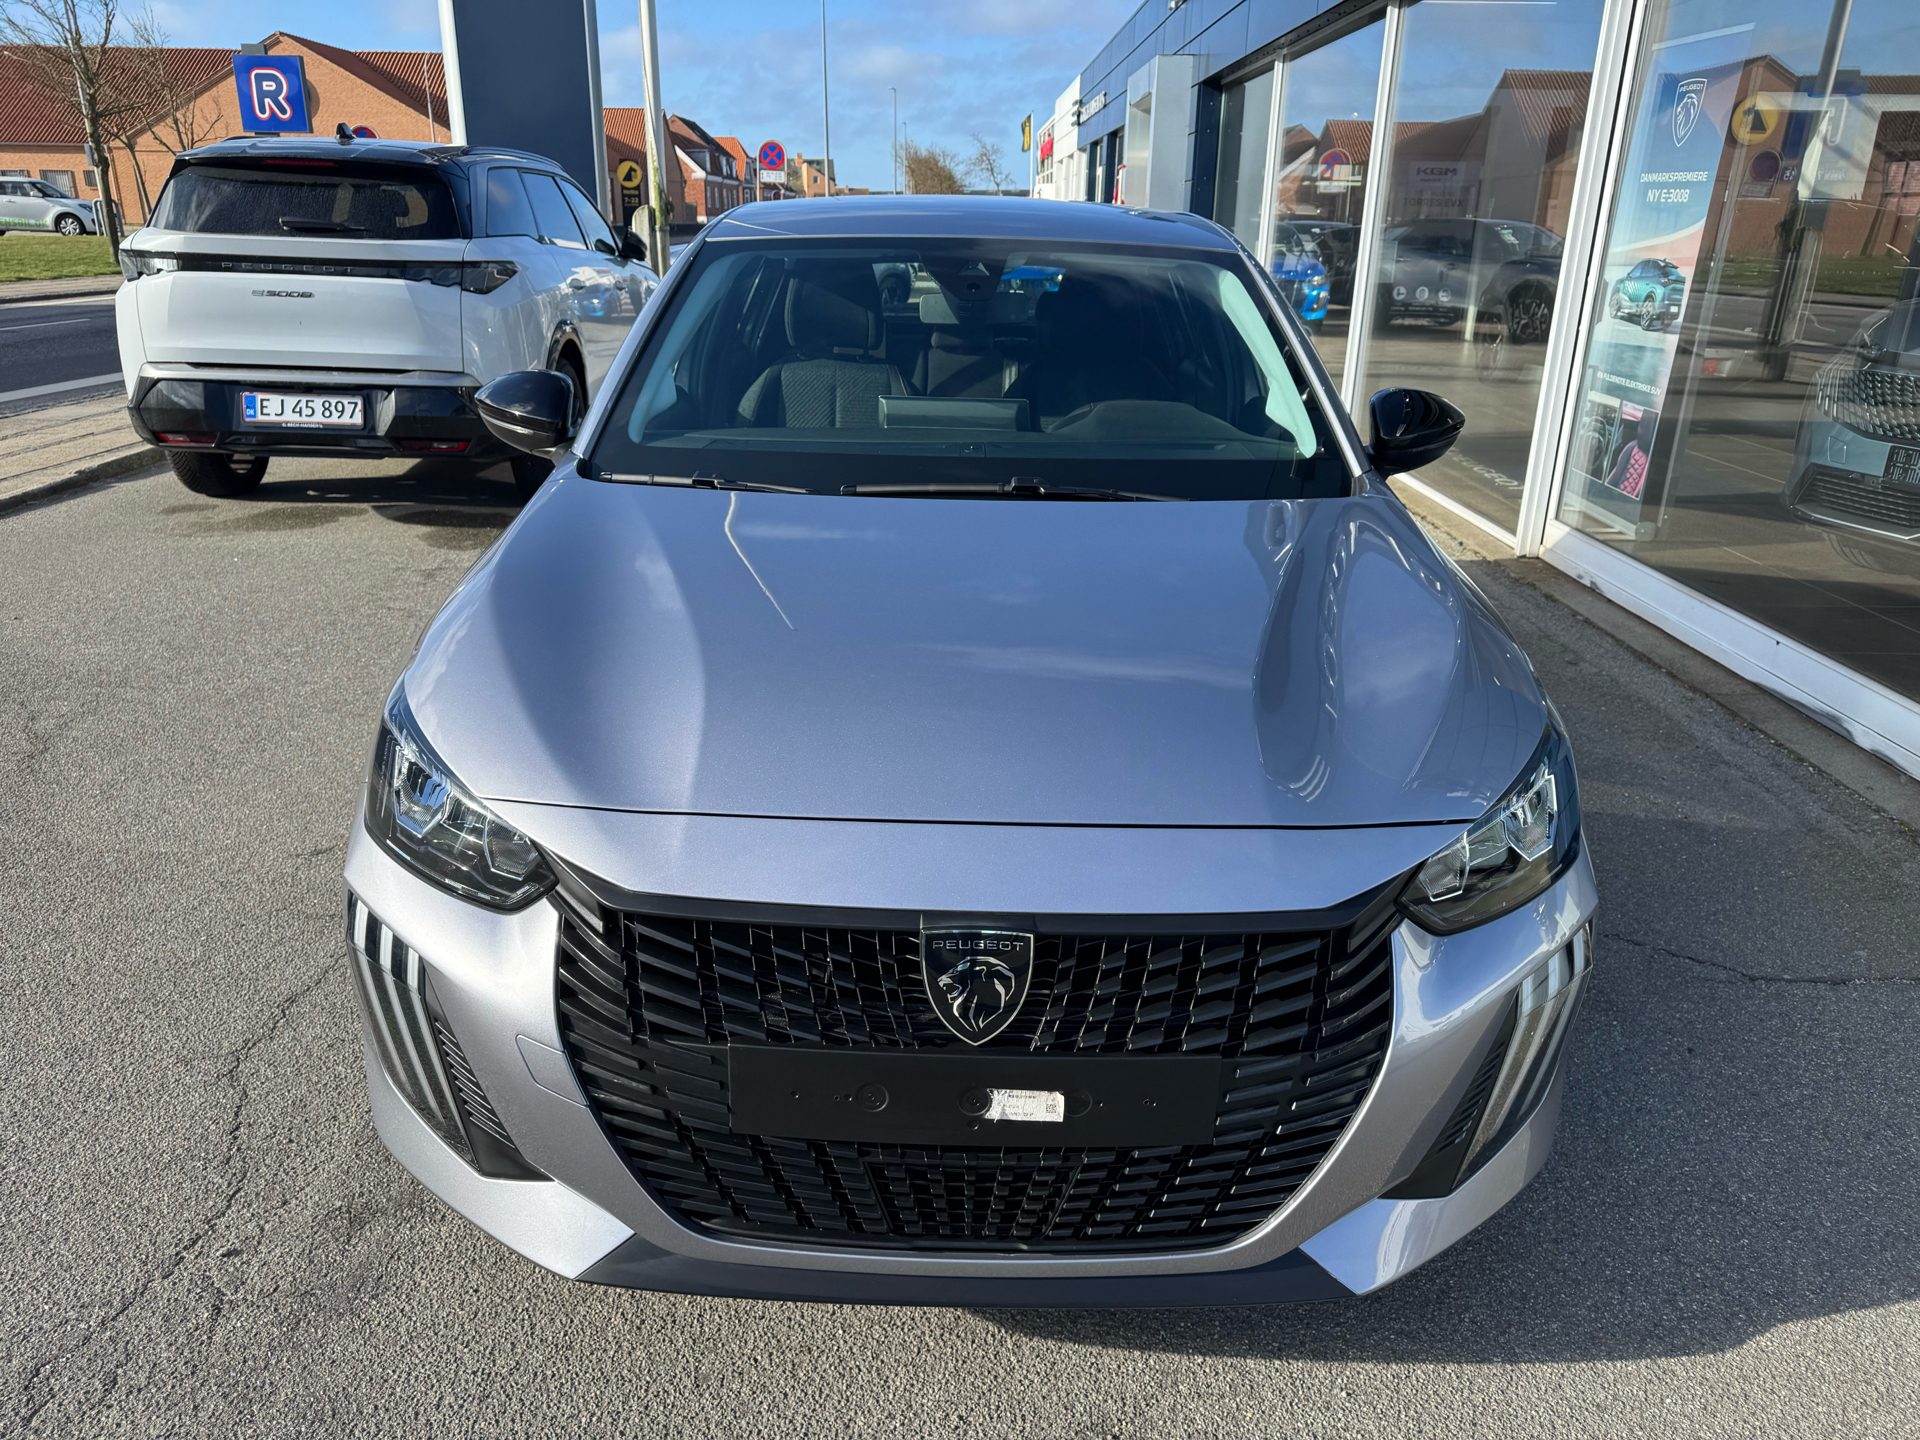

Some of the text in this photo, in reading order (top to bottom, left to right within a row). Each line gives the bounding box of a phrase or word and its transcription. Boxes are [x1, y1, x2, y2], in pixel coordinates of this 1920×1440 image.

[1679, 83, 1704, 92] PEUGEOT
[249, 67, 293, 121] R
[1416, 167, 1458, 176] KGM
[1640, 171, 1708, 183] DANMARKSPREMIERE
[1646, 189, 1690, 202] NY E-3008
[221, 261, 356, 273] PEUGEOT
[1651, 386, 1662, 395] SUV
[246, 408, 255, 416] DK
[291, 399, 315, 418] 45
[321, 400, 359, 419] 897
[932, 940, 1024, 951] PEUGEOT
